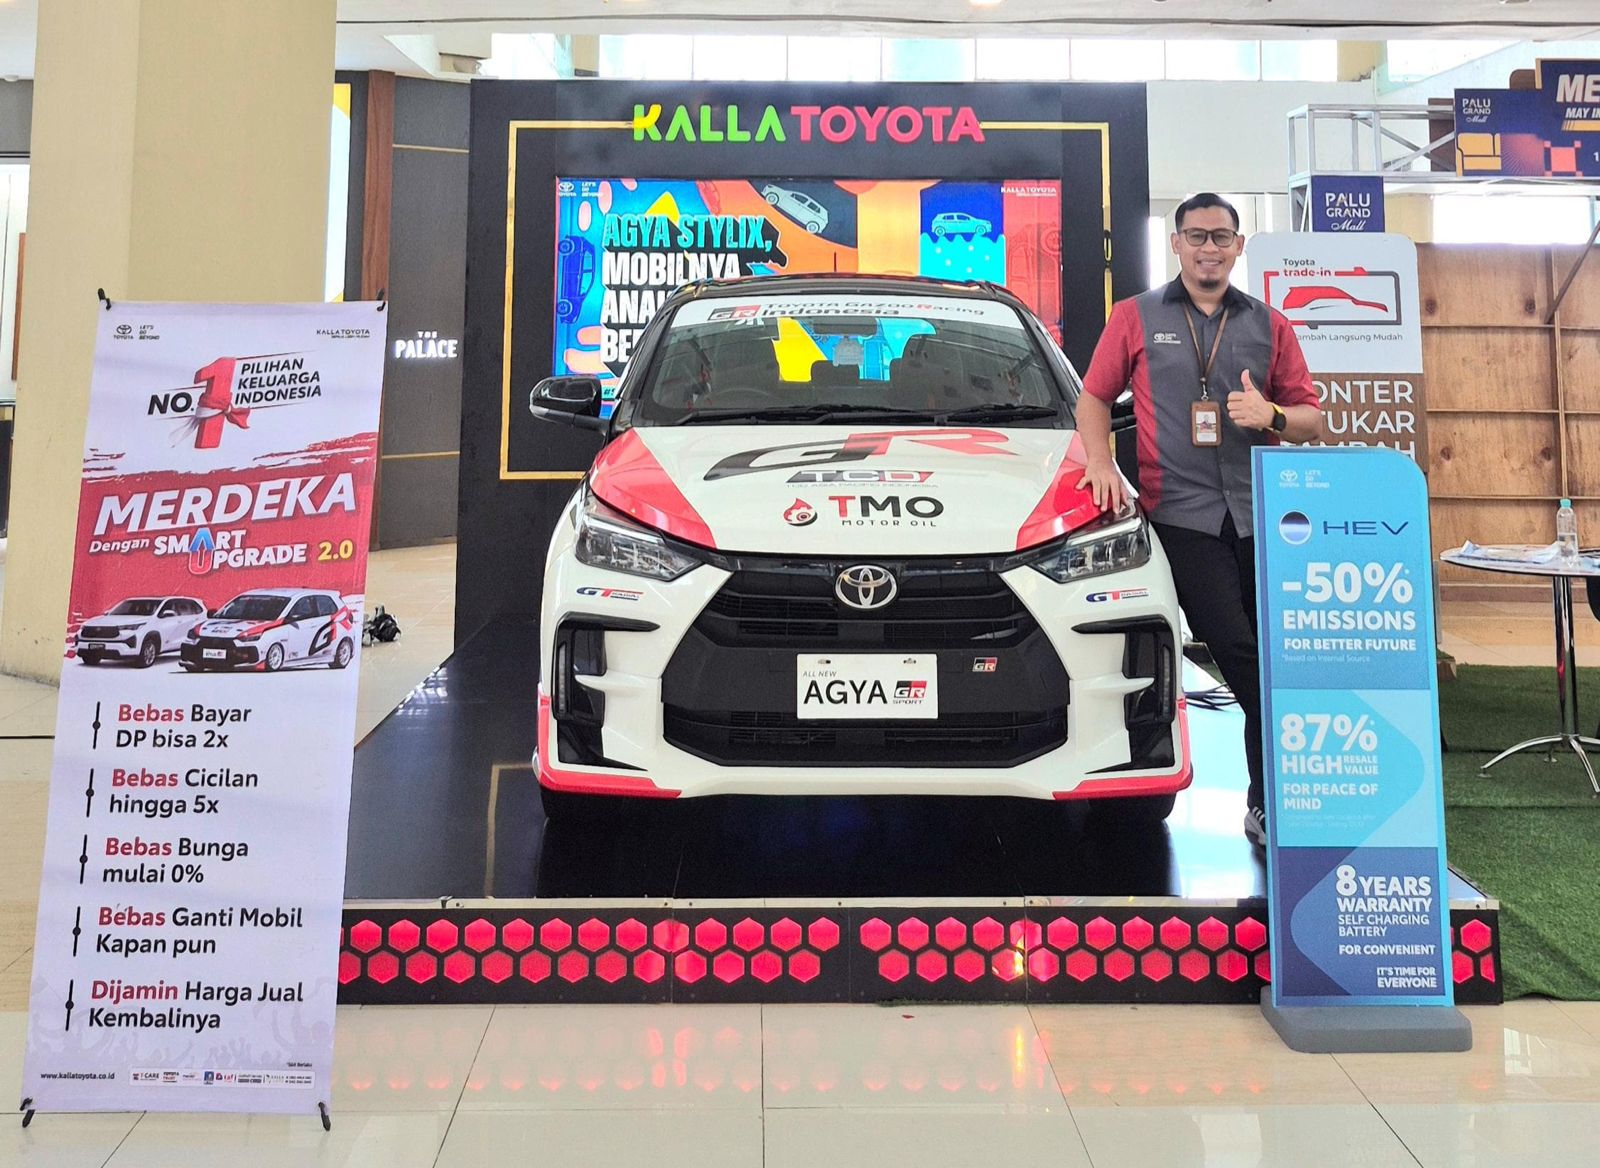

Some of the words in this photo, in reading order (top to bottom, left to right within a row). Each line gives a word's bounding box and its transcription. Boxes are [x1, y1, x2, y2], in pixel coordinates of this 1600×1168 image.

[1462, 98, 1490, 108] PALU
[1565, 107, 1590, 119] MAY
[633, 104, 786, 142] KALLA
[791, 105, 986, 143] TOYOTA
[1325, 192, 1370, 208] PALU
[1326, 208, 1371, 218] GRAND
[603, 214, 670, 248] AGYA
[677, 214, 773, 252] STYLIX,
[1330, 219, 1366, 231] Mall
[602, 252, 741, 286] MOBILNYA
[1283, 258, 1316, 268] Toyota
[1283, 268, 1332, 277] trade-in
[708, 306, 761, 320] GR
[601, 328, 641, 363] BE
[1329, 333, 1372, 343] Langsung
[395, 339, 458, 359] PALACE
[241, 358, 304, 375] PILIHAN
[238, 370, 320, 390] KELUARGA
[234, 385, 322, 405] INDONESIA
[1312, 380, 1414, 404] ONTER
[1321, 410, 1416, 434] UKAR
[703, 428, 1021, 481] GR
[794, 470, 926, 483] TCD
[93, 472, 356, 536] MERDEKA
[828, 496, 944, 518] TMO
[1323, 520, 1409, 536] HEV
[89, 538, 149, 554] Dengan
[154, 528, 247, 556] SMART
[188, 544, 308, 575] UPGRADE
[318, 540, 353, 561] 2.0
[1282, 610, 1416, 631] EMISSIONS
[1284, 638, 1311, 651] FOR
[1314, 638, 1362, 651] BETTER
[1366, 639, 1417, 651] FUTURE
[803, 670, 817, 678] ALL
[818, 670, 838, 678] NEW
[973, 660, 997, 672] GR
[804, 680, 888, 704] AGYA
[894, 684, 926, 698] GR
[118, 703, 184, 722] Bebas
[191, 704, 252, 727] Bayar
[116, 730, 147, 748] DP
[152, 728, 197, 748] bisa
[202, 730, 229, 748] 2x
[1281, 754, 1343, 775] HIGH
[1343, 755, 1378, 764] RESALE
[1344, 765, 1379, 775] VALUE
[112, 768, 178, 787] Bebas
[184, 768, 258, 788] Cicilan
[1283, 783, 1310, 795] FOR
[1312, 783, 1357, 795] PEACE
[1359, 783, 1379, 795] OF
[110, 794, 187, 819] hingga
[192, 795, 220, 814] 5x
[1284, 798, 1322, 810] MIND
[105, 836, 172, 856] Bebas
[178, 837, 249, 862] Bunga
[102, 863, 166, 883] mulai
[171, 864, 204, 884] 0%
[1336, 864, 1358, 896] 8
[1358, 876, 1432, 896] YEARS
[1336, 897, 1432, 912] WARRANTY
[98, 906, 166, 926] Bebas
[172, 906, 234, 927] Ganti
[239, 907, 303, 928] Mobil
[1338, 914, 1364, 925] SELF
[1366, 914, 1430, 925] CHARGING
[1338, 926, 1387, 937] BATTERY
[96, 933, 166, 958] Kapan
[173, 938, 216, 958] pun
[1339, 944, 1362, 955] FOR
[1363, 944, 1436, 955] CONVENIENT
[1376, 966, 1394, 976] IT'S
[1394, 966, 1417, 976] TIME
[1418, 966, 1436, 976] FOR
[91, 979, 178, 1005] Dijamin
[184, 981, 252, 1006] Harga
[257, 982, 304, 1002] Jual
[1377, 978, 1438, 988] EVERYONE
[88, 1007, 221, 1034] Kembalinya
[40, 1072, 115, 1081] www.kallatoyota.co.id
